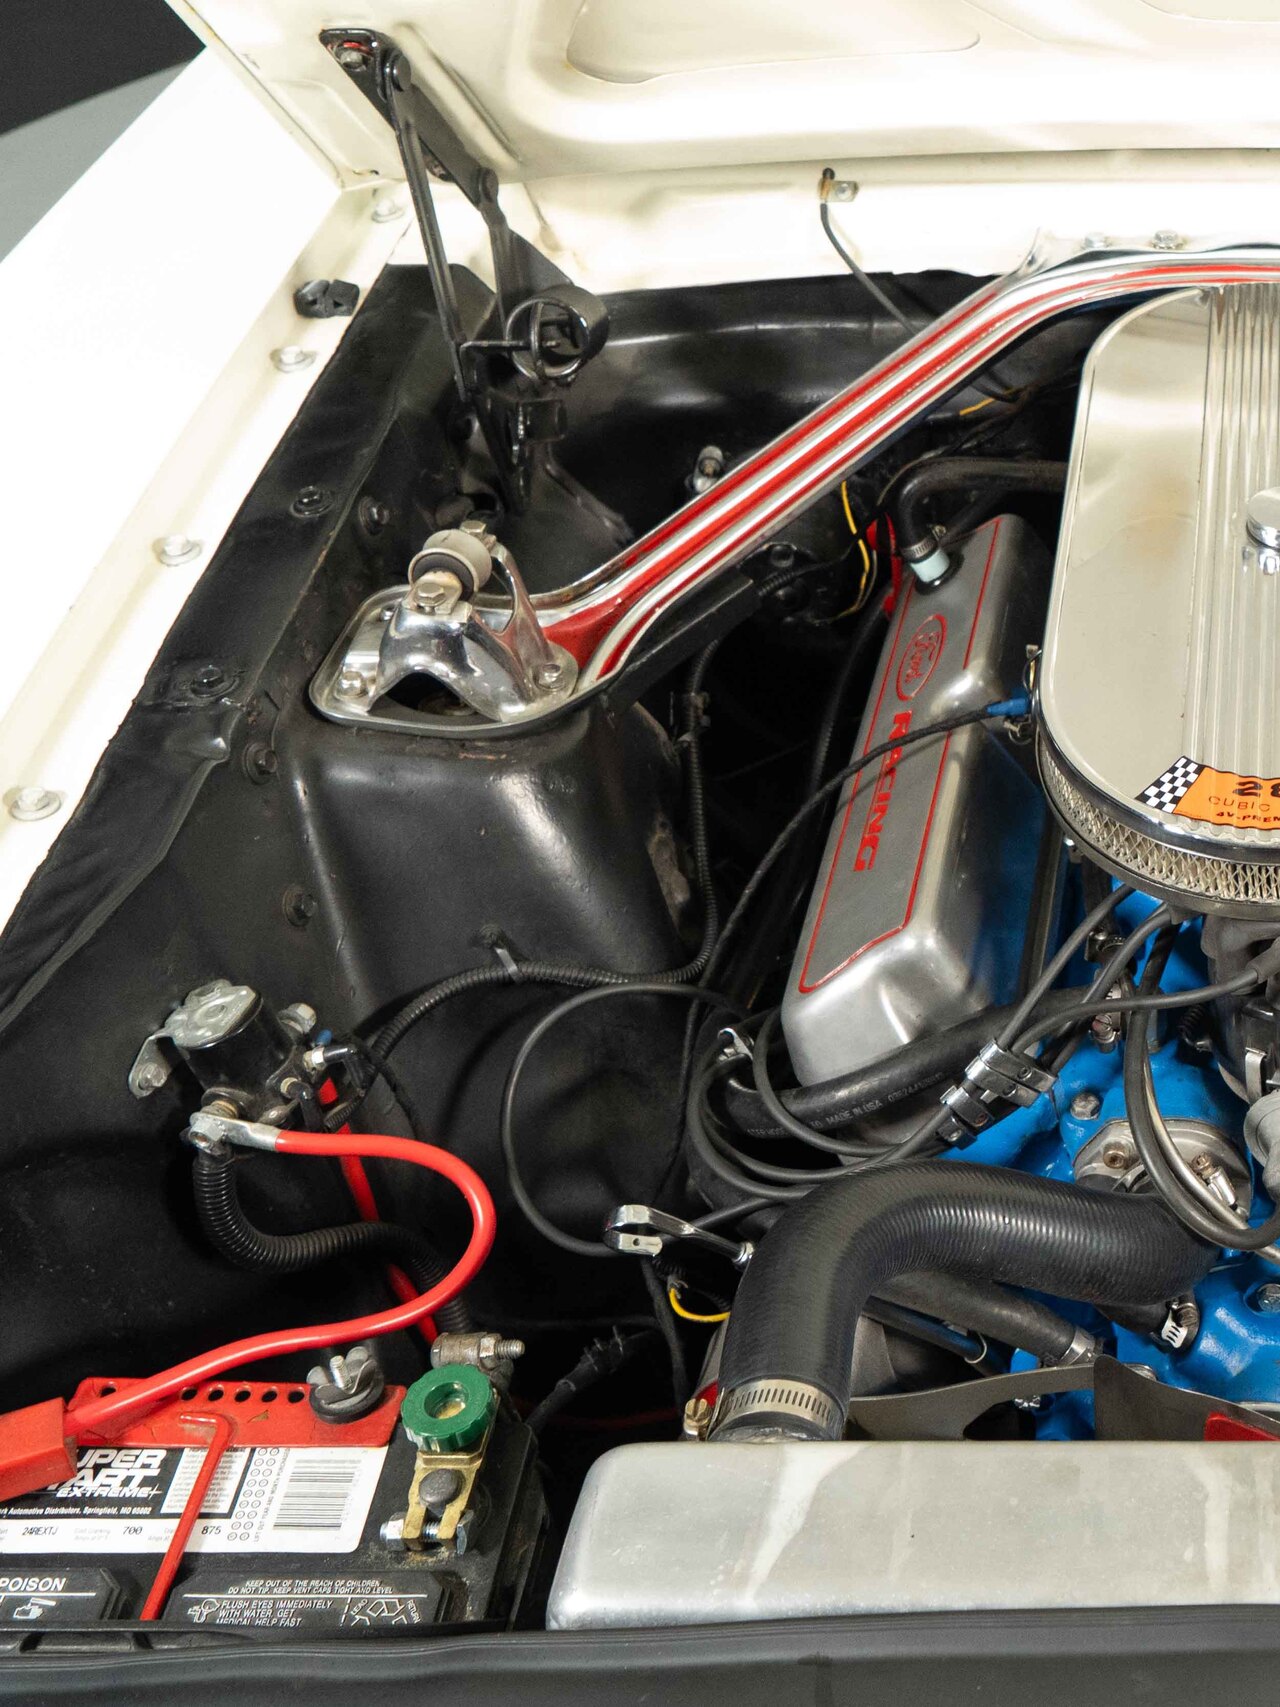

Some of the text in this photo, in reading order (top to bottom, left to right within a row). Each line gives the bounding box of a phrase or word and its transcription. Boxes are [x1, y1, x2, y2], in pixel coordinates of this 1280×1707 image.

[904, 630, 940, 684] Ford
[1208, 795, 1270, 812] CUBIC
[826, 1100, 884, 1124] MADE IN USA
[76, 1449, 167, 1468] UPER
[47, 1468, 161, 1490] ART
[8, 1507, 44, 1515] Automotive
[120, 1506, 131, 1515] MO
[122, 1526, 143, 1535] 700
[201, 1525, 221, 1535] 875
[0, 1577, 67, 1592] POISON
[245, 1580, 264, 1588] KEEP
[265, 1580, 280, 1588] OUT
[295, 1580, 308, 1588] THE
[310, 1580, 333, 1588] REACH
[221, 1600, 333, 1609] FLUSH EYES IMMEDIATELY
[219, 1609, 241, 1618] WITH
[276, 1609, 295, 1618] GET
[255, 1618, 278, 1627] HELP
[279, 1618, 302, 1627] FAST
